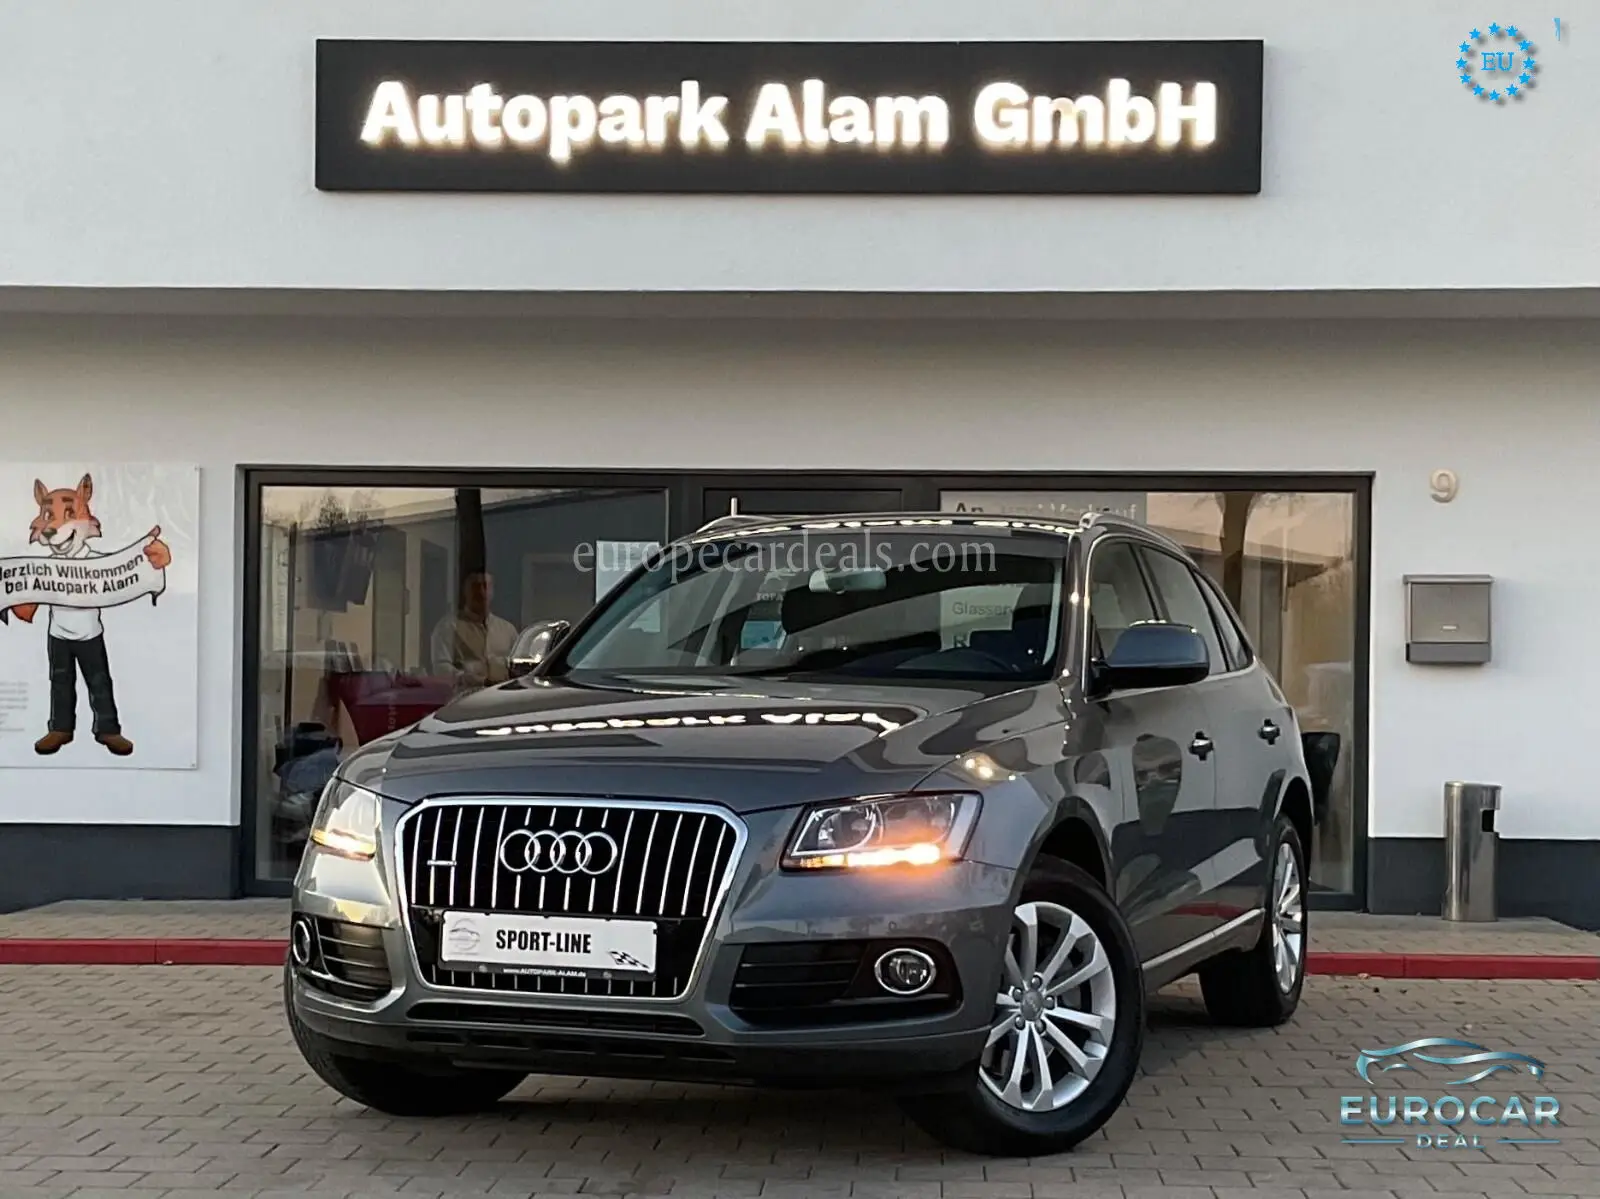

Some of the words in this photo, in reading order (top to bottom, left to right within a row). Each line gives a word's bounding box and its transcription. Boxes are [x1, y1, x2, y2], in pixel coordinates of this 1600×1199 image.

[360, 79, 731, 163] Autopark
[745, 78, 950, 146] Alam
[973, 78, 1218, 146] GmbH
[1430, 467, 1459, 503] 9
[56, 554, 144, 580] Willkommen
[5, 577, 28, 594] bei
[33, 577, 98, 595] Autopark
[102, 572, 139, 593] Alam
[496, 929, 592, 954] SPORT-LINE
